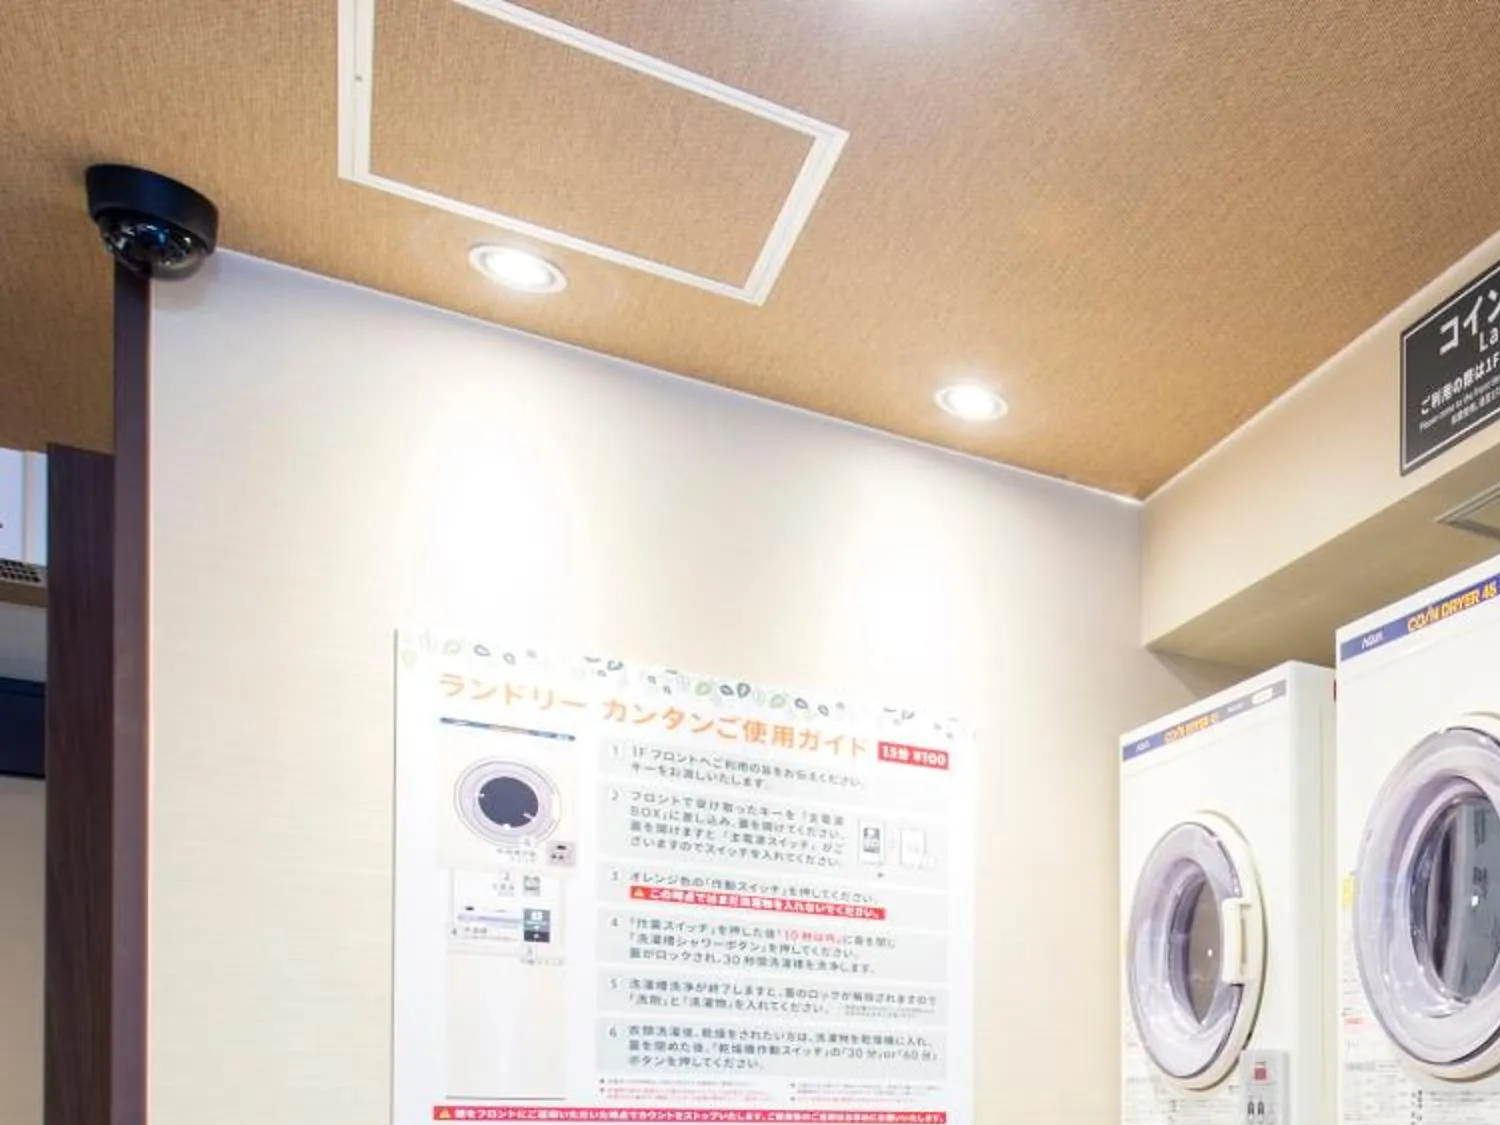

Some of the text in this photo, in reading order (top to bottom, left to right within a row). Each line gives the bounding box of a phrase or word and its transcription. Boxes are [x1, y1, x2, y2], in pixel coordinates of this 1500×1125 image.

[438, 671, 868, 757] ランドリー カンタンご使用ガイド
